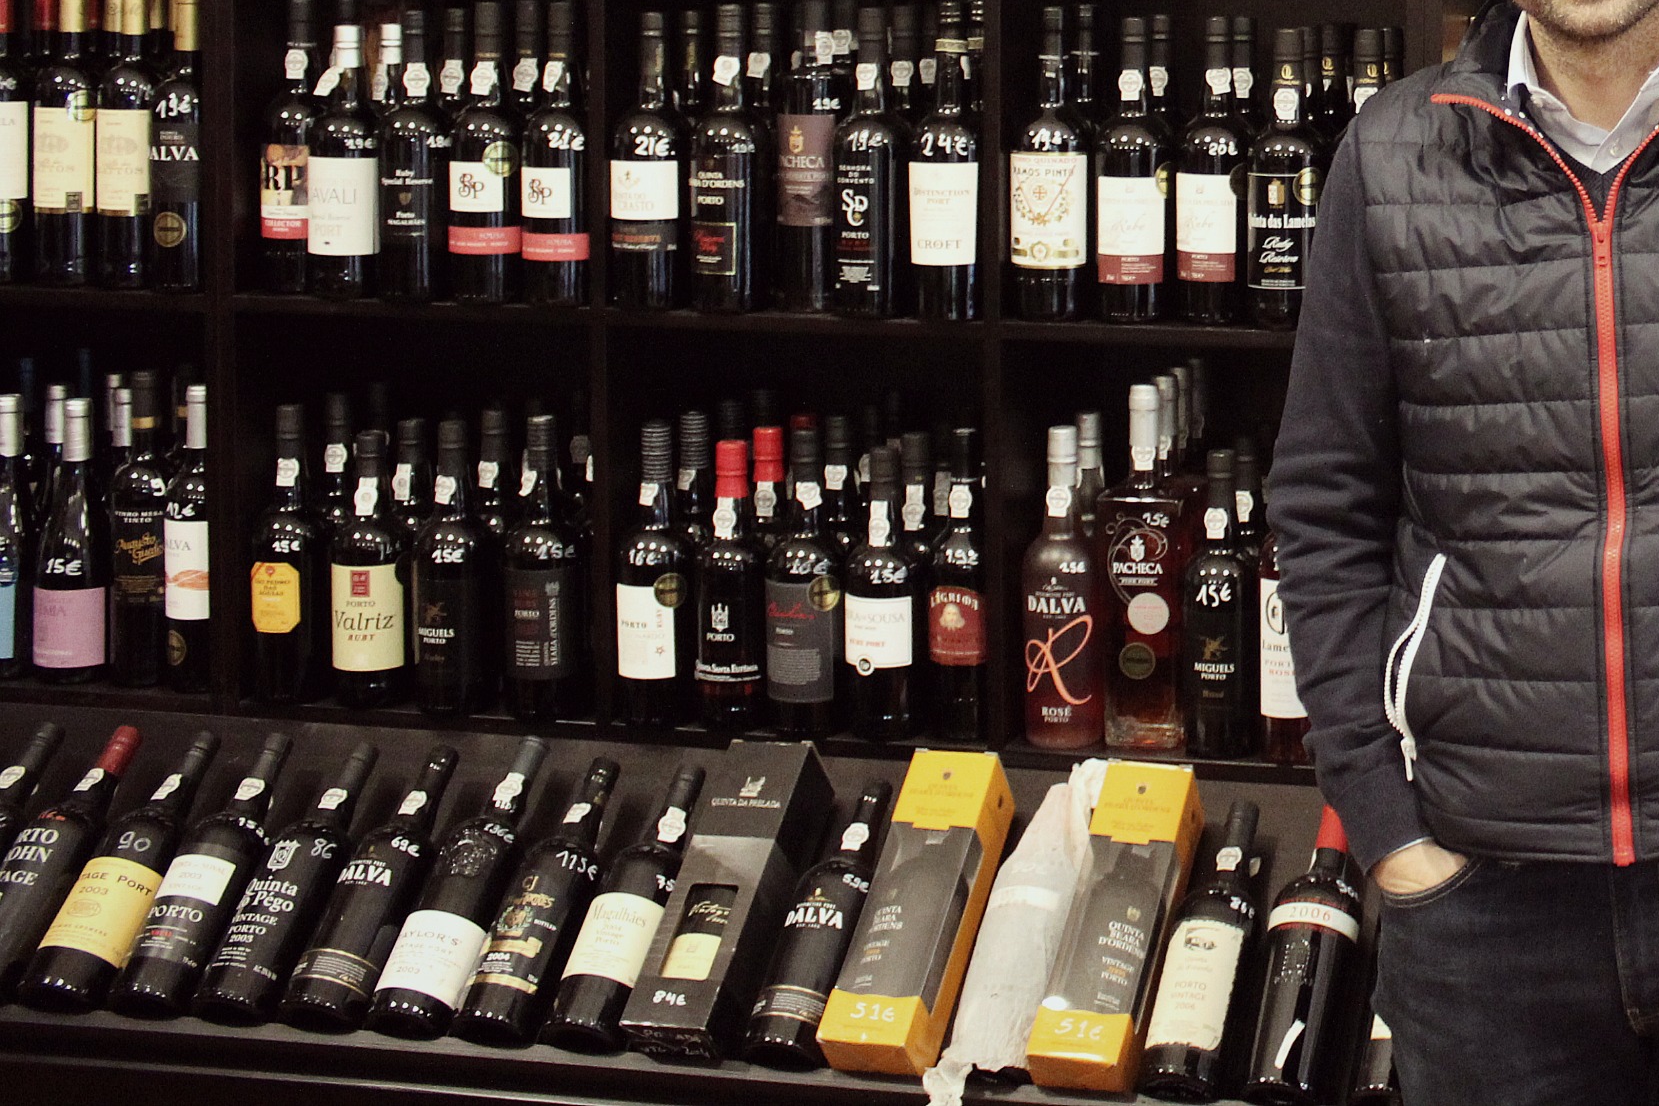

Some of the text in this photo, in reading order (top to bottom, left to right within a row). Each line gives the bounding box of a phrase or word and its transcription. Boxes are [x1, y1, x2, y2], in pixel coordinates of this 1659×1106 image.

[697, 196, 724, 206] PORTO
[841, 231, 870, 240] PORTO
[917, 239, 963, 250] CROFT
[167, 503, 195, 520] 12€
[272, 540, 300, 553] 15€
[432, 549, 464, 563] 15€
[46, 558, 83, 576] 15€
[1112, 562, 1163, 574] PACHECA
[1027, 594, 1086, 613] DALVA
[1196, 583, 1232, 607] 15€
[333, 610, 397, 632] Valriz
[706, 632, 735, 642] PORTO
[1194, 662, 1235, 674] MIGUELS
[1041, 705, 1072, 717] ROSÉ
[310, 837, 337, 859] 86
[337, 863, 393, 887] DALVA
[117, 874, 153, 896] PORT
[246, 877, 299, 897] Quinta
[253, 892, 295, 914] Pégo
[148, 905, 203, 923] PORTO
[590, 903, 648, 929] Magalhães
[784, 907, 843, 929] DALVA
[1289, 906, 1332, 922] 2006
[229, 933, 254, 944] 2003
[1108, 920, 1145, 940] QUINTA
[1101, 956, 1135, 974] VINTAGE
[1100, 971, 1127, 986] PORTO
[652, 989, 687, 1006] 84€
